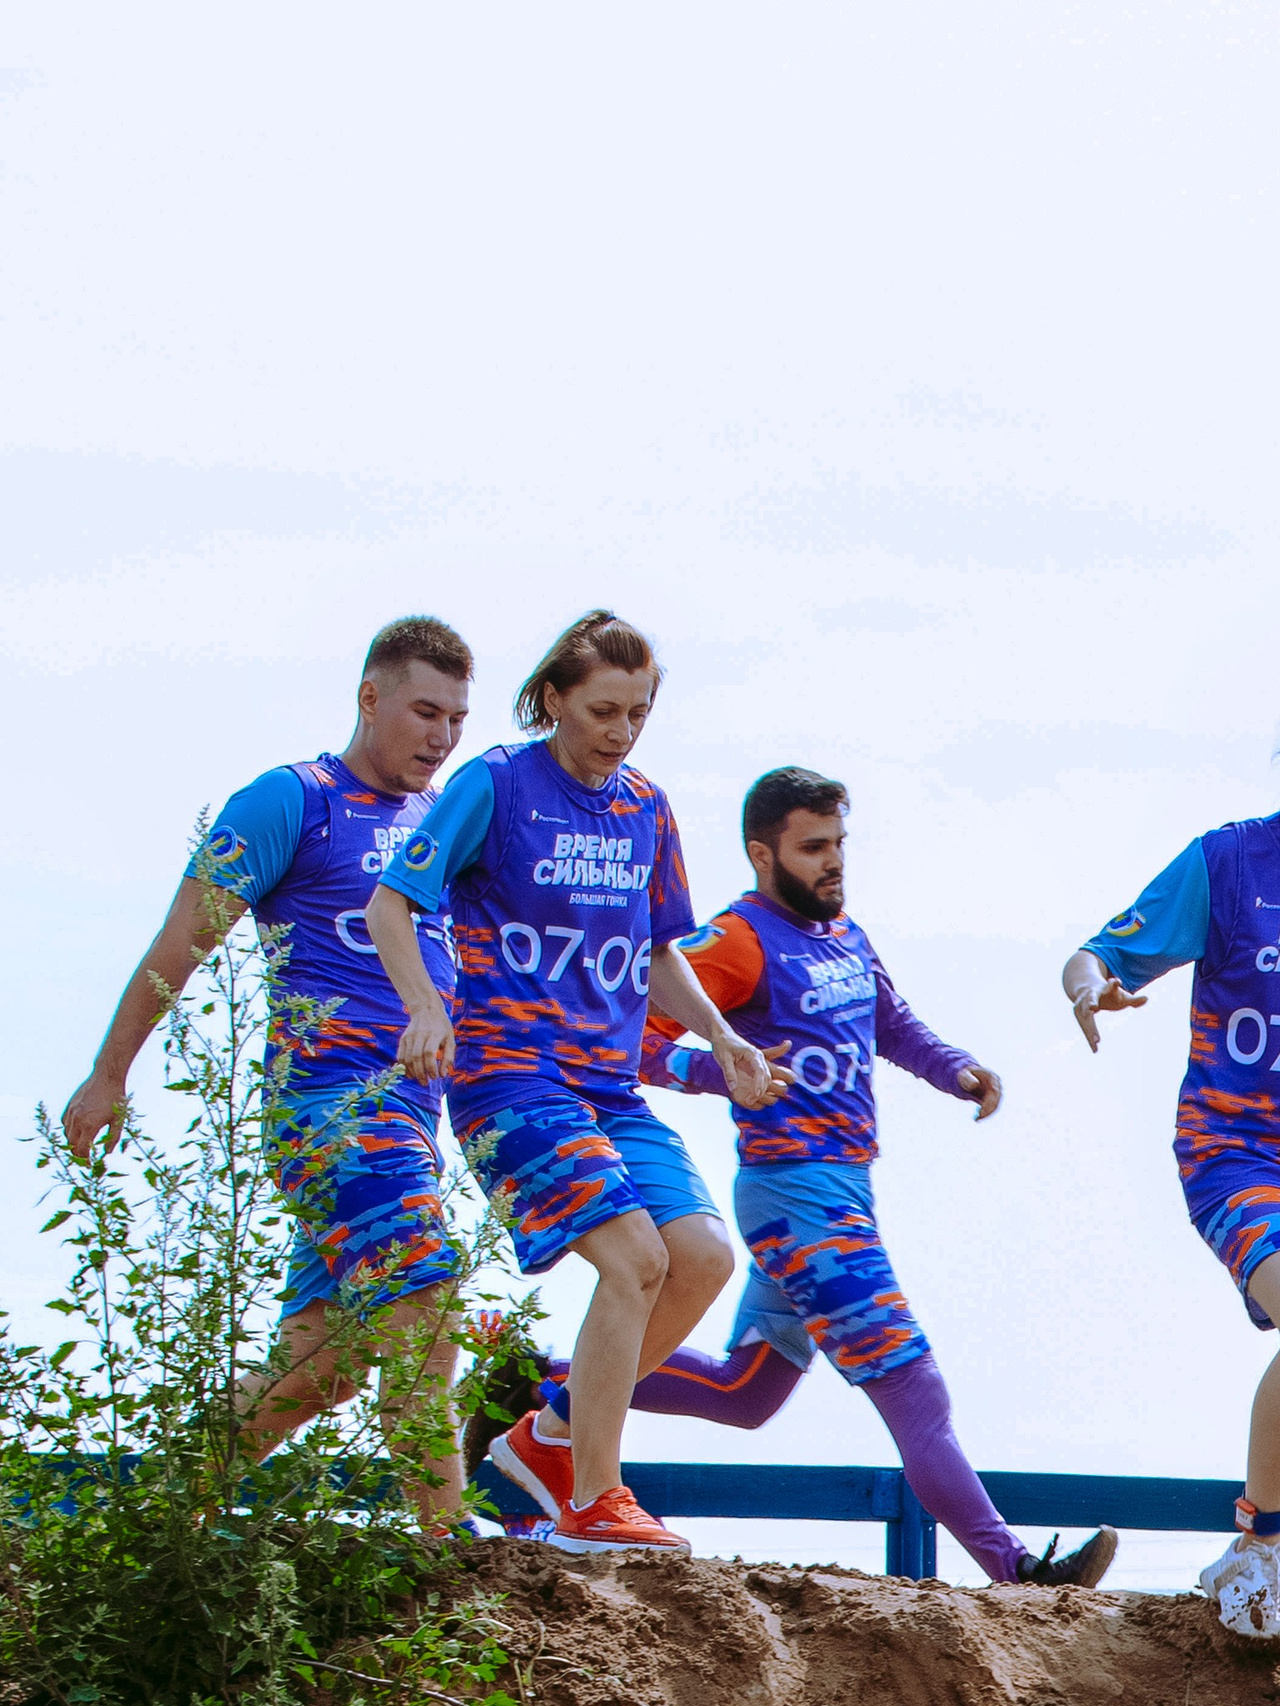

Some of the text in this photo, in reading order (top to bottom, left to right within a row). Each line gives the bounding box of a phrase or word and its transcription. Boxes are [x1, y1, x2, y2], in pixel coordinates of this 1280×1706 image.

[374, 826, 417, 850] ВРЕ
[554, 833, 633, 862] ВРЕМЯ
[801, 973, 877, 1015] СИЛЬНЫ
[791, 1040, 877, 1095] 07-
